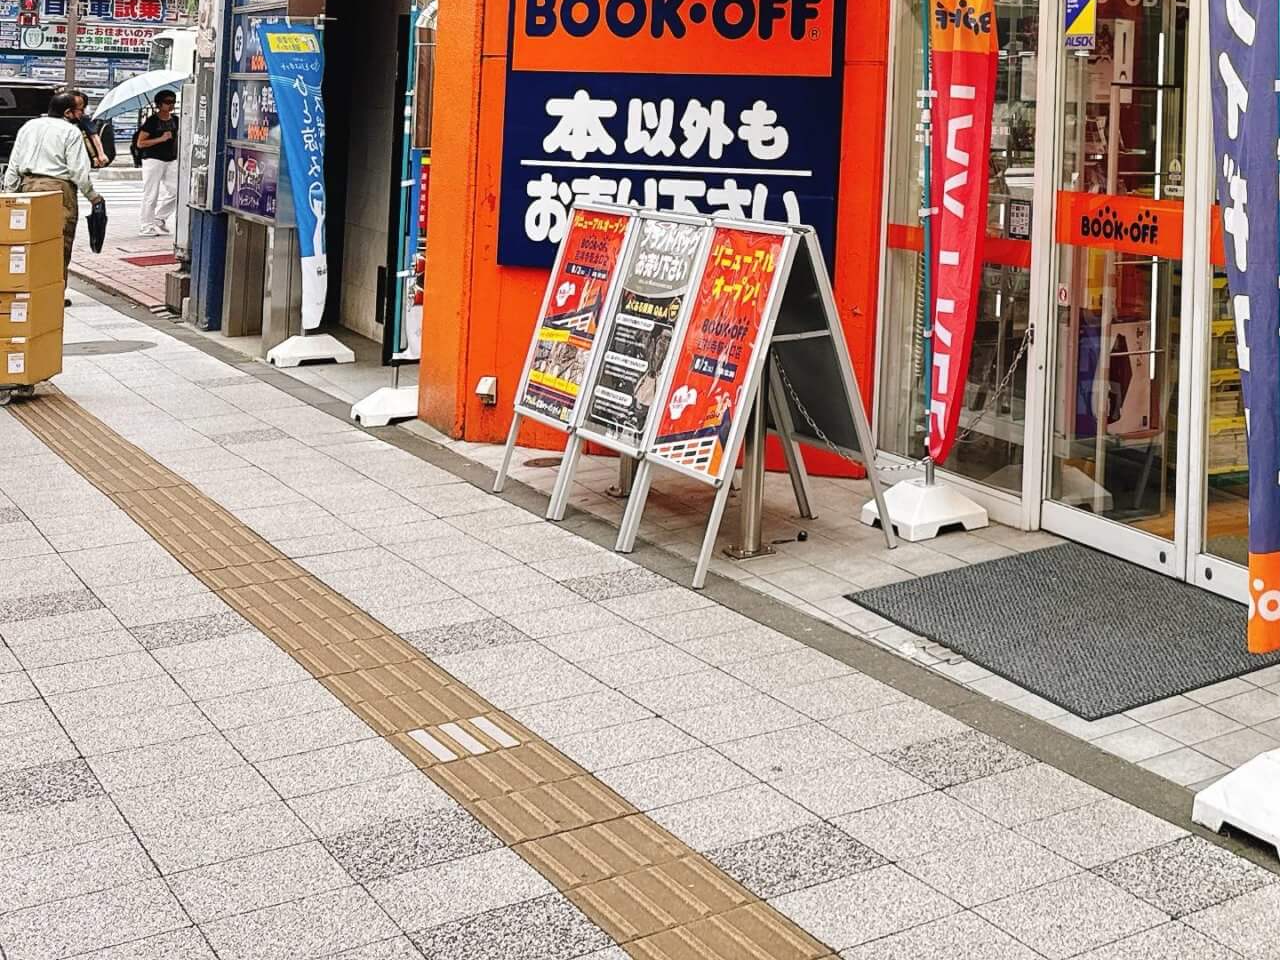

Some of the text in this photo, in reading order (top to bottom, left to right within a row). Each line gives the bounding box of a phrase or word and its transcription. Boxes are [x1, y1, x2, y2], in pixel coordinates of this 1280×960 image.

[1065, 36, 1094, 47] ALSOK
[714, 245, 775, 273] リニューアル
[712, 276, 761, 307] オープン!
